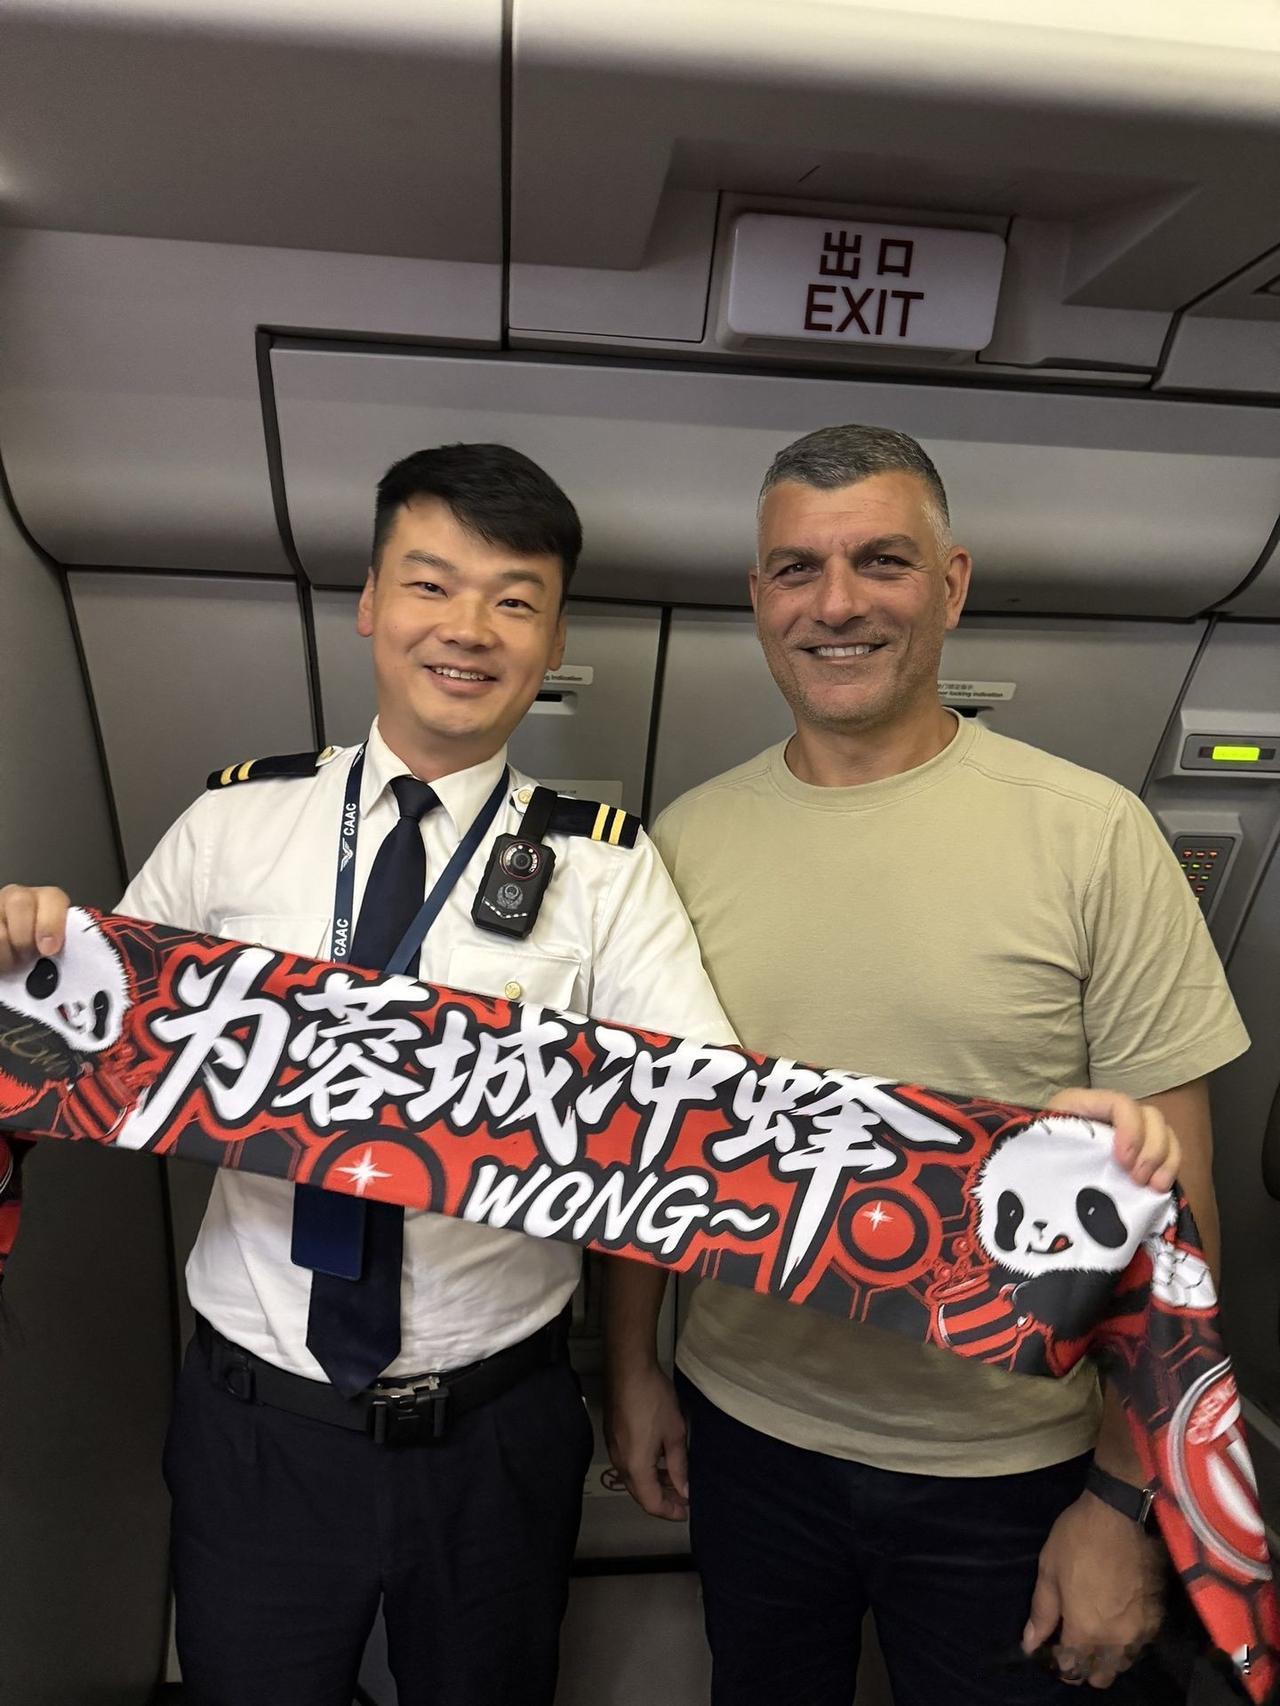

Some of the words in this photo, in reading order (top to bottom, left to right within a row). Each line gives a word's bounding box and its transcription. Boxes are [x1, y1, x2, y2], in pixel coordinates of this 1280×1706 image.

[819, 231, 914, 279] 出口
[804, 284, 924, 337] EXIT
[343, 802, 357, 837] CAAC
[334, 918, 349, 957] CAAC
[116, 948, 962, 1290] 为蓉城冲蜂
